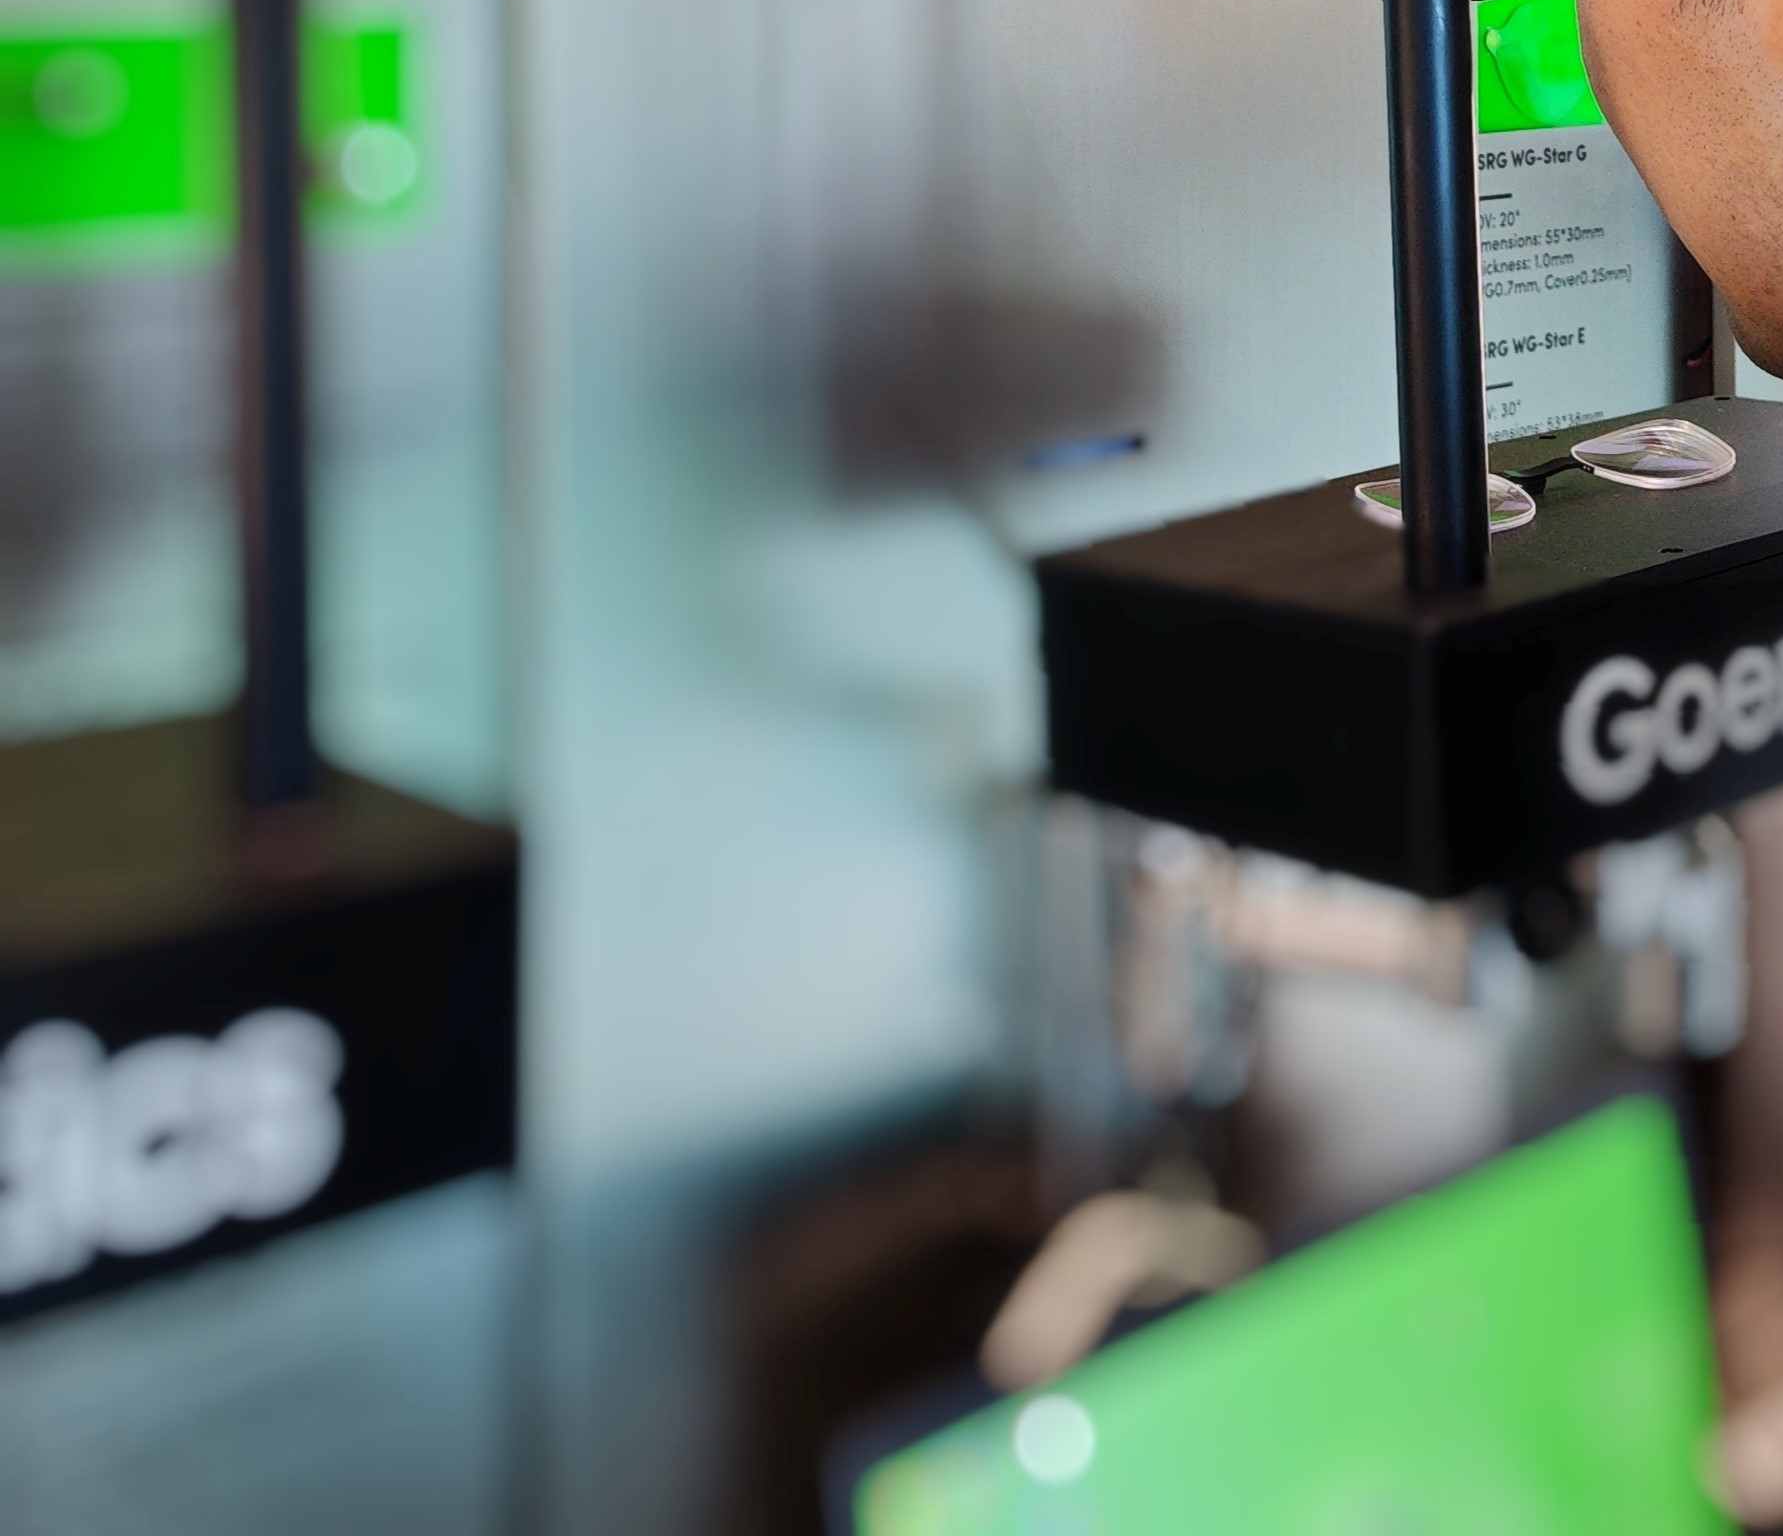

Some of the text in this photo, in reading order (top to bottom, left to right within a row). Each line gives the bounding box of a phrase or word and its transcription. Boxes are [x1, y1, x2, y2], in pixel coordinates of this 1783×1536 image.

[1478, 144, 1588, 171] SRG WG-Star G
[1499, 209, 1521, 228] 20°
[1512, 331, 1575, 355] WG-Star
[1577, 326, 1587, 344] E
